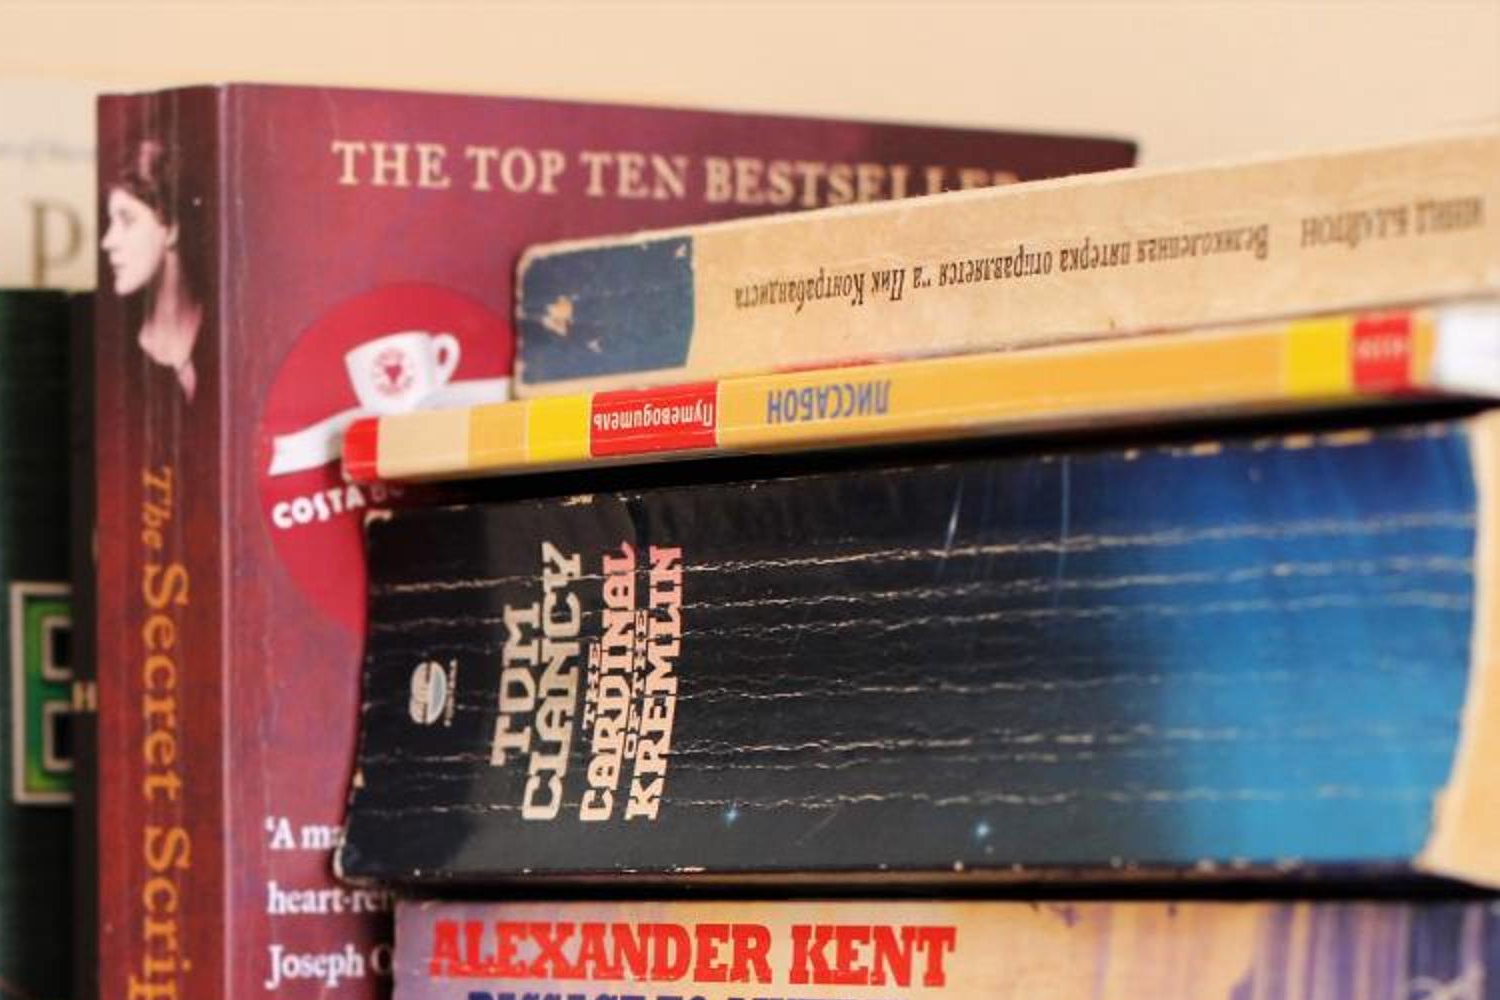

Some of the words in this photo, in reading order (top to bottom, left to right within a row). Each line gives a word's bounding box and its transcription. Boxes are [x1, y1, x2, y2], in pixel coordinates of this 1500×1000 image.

[331, 140, 451, 189] THE
[466, 146, 566, 195] TOP
[585, 152, 688, 199] TEN
[734, 266, 866, 313] Контрабандиста
[872, 264, 905, 300] Пик
[912, 264, 932, 290] а
[593, 403, 714, 429] Путеводитель
[767, 378, 892, 425] ЛИССАБОН
[141, 464, 174, 551] The
[272, 485, 367, 529] COSTA
[141, 562, 191, 802] Secret
[490, 601, 539, 767] TOM
[522, 540, 582, 821] CLANCY
[625, 545, 682, 820] KREMLIN
[264, 943, 365, 991] Joseph
[429, 919, 773, 985] ALEXANDER
[789, 925, 956, 988] KENT
